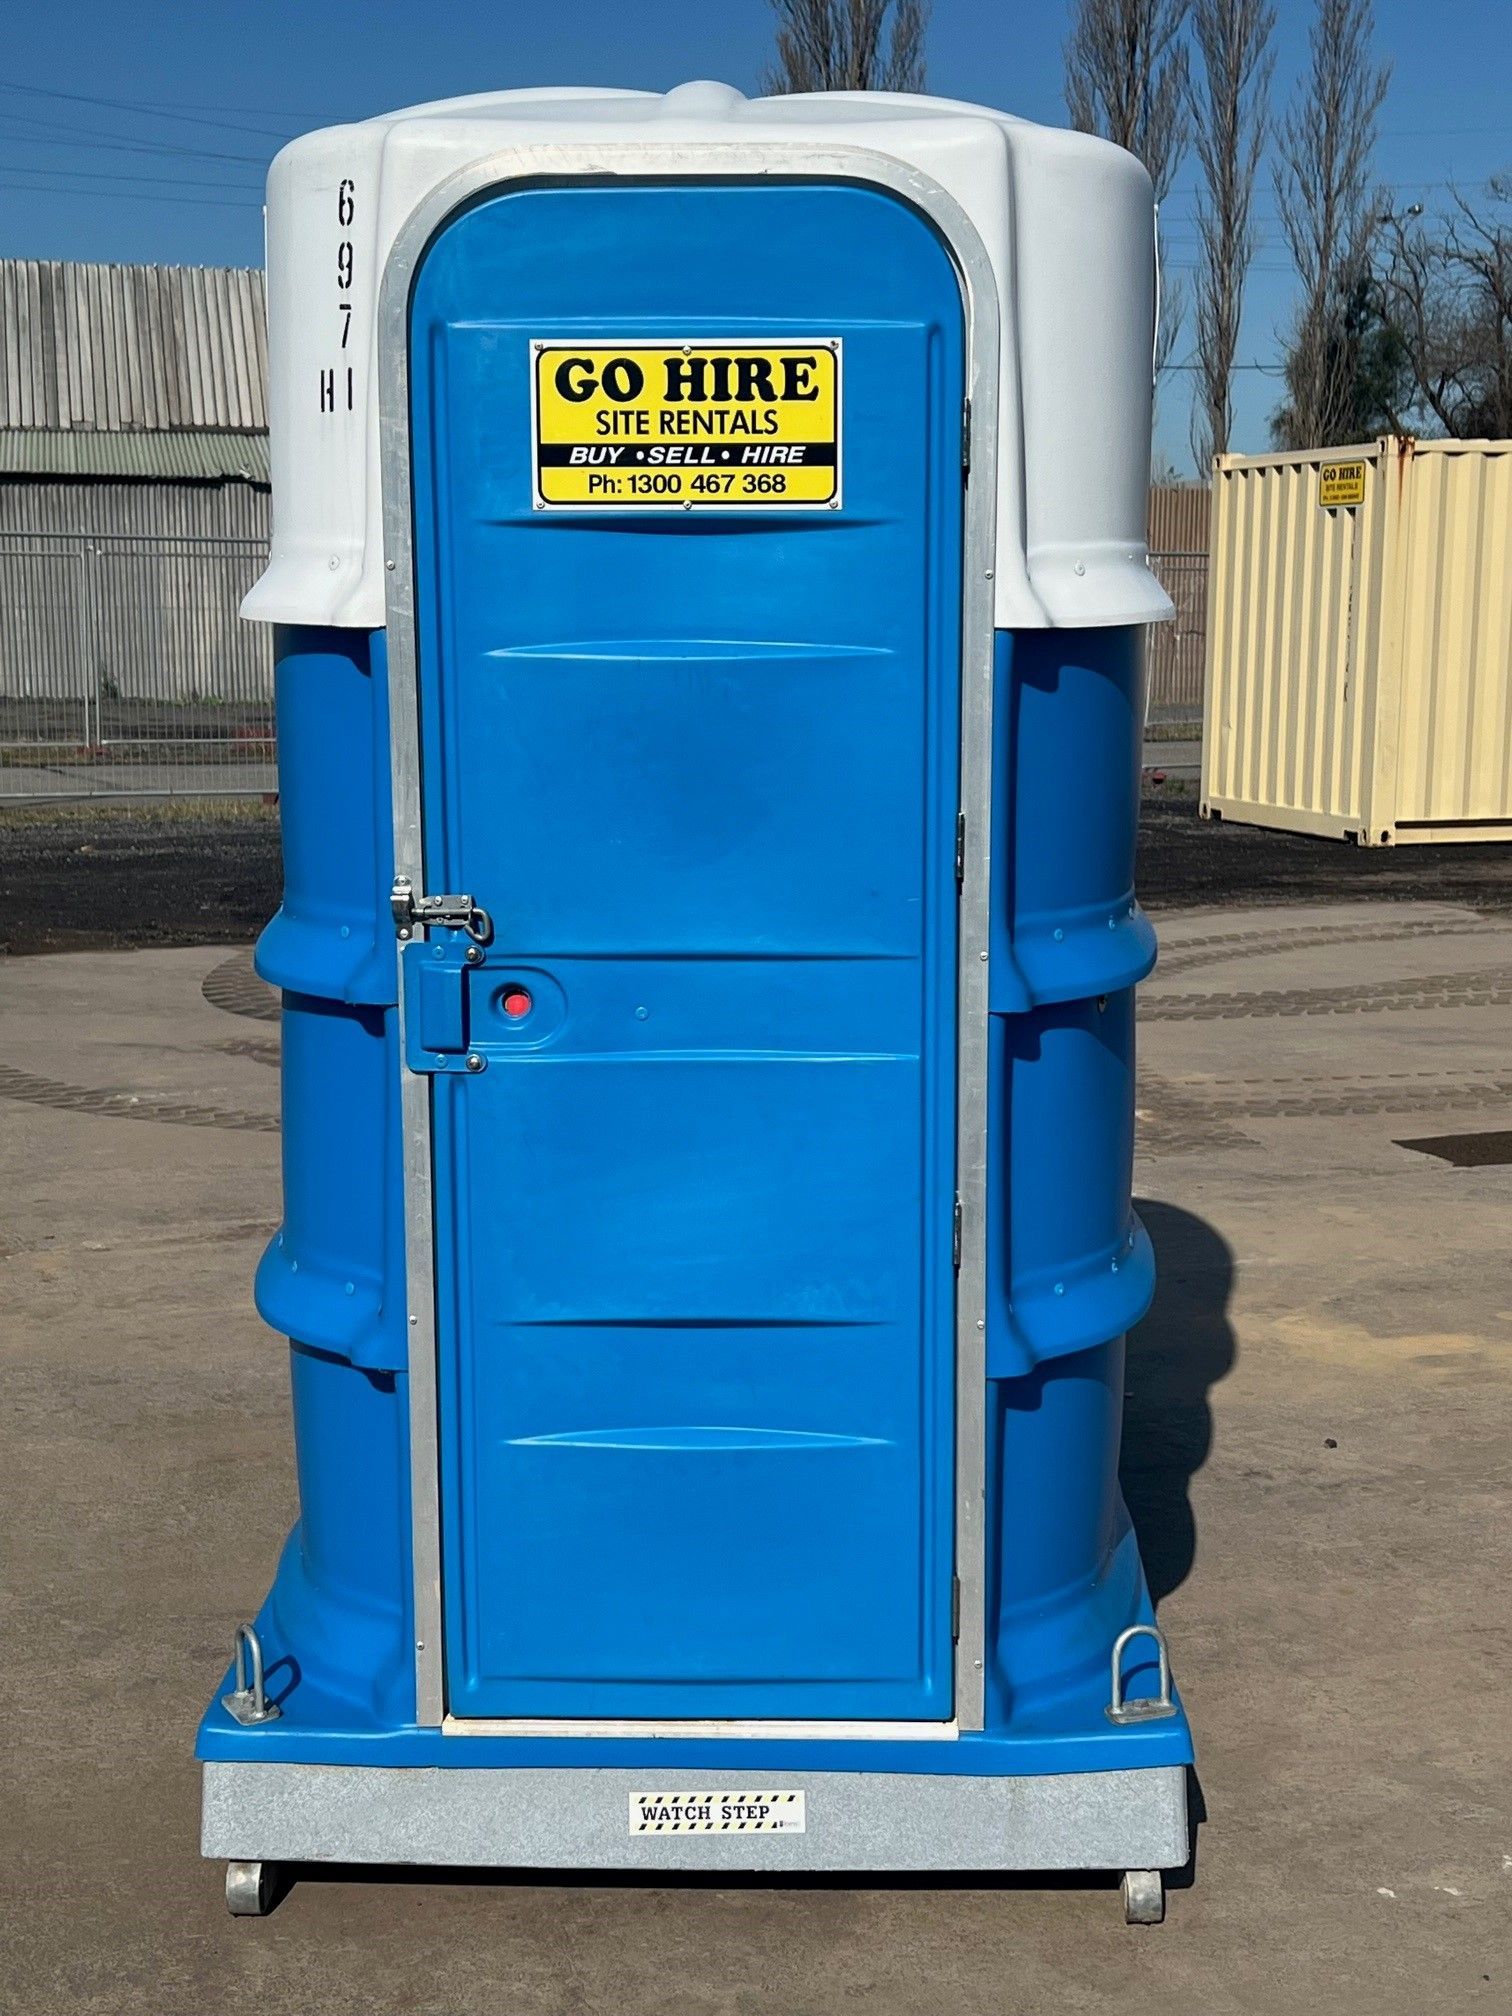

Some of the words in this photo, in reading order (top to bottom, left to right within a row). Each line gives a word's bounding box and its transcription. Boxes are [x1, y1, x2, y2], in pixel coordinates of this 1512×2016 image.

[555, 357, 644, 403] GO
[663, 356, 819, 403] HIRE
[595, 410, 650, 436] SITE
[659, 409, 779, 435] RENTALS
[569, 446, 625, 465] BUY
[741, 446, 806, 464] HIRE
[588, 475, 623, 494] Ph:
[626, 474, 682, 494] 1300
[690, 474, 736, 493] 467
[742, 473, 786, 493] 368
[1323, 468, 1336, 481] GO
[1339, 466, 1362, 480] HIRE
[641, 1806, 711, 1821] WATCH
[721, 1805, 770, 1819] STEP
